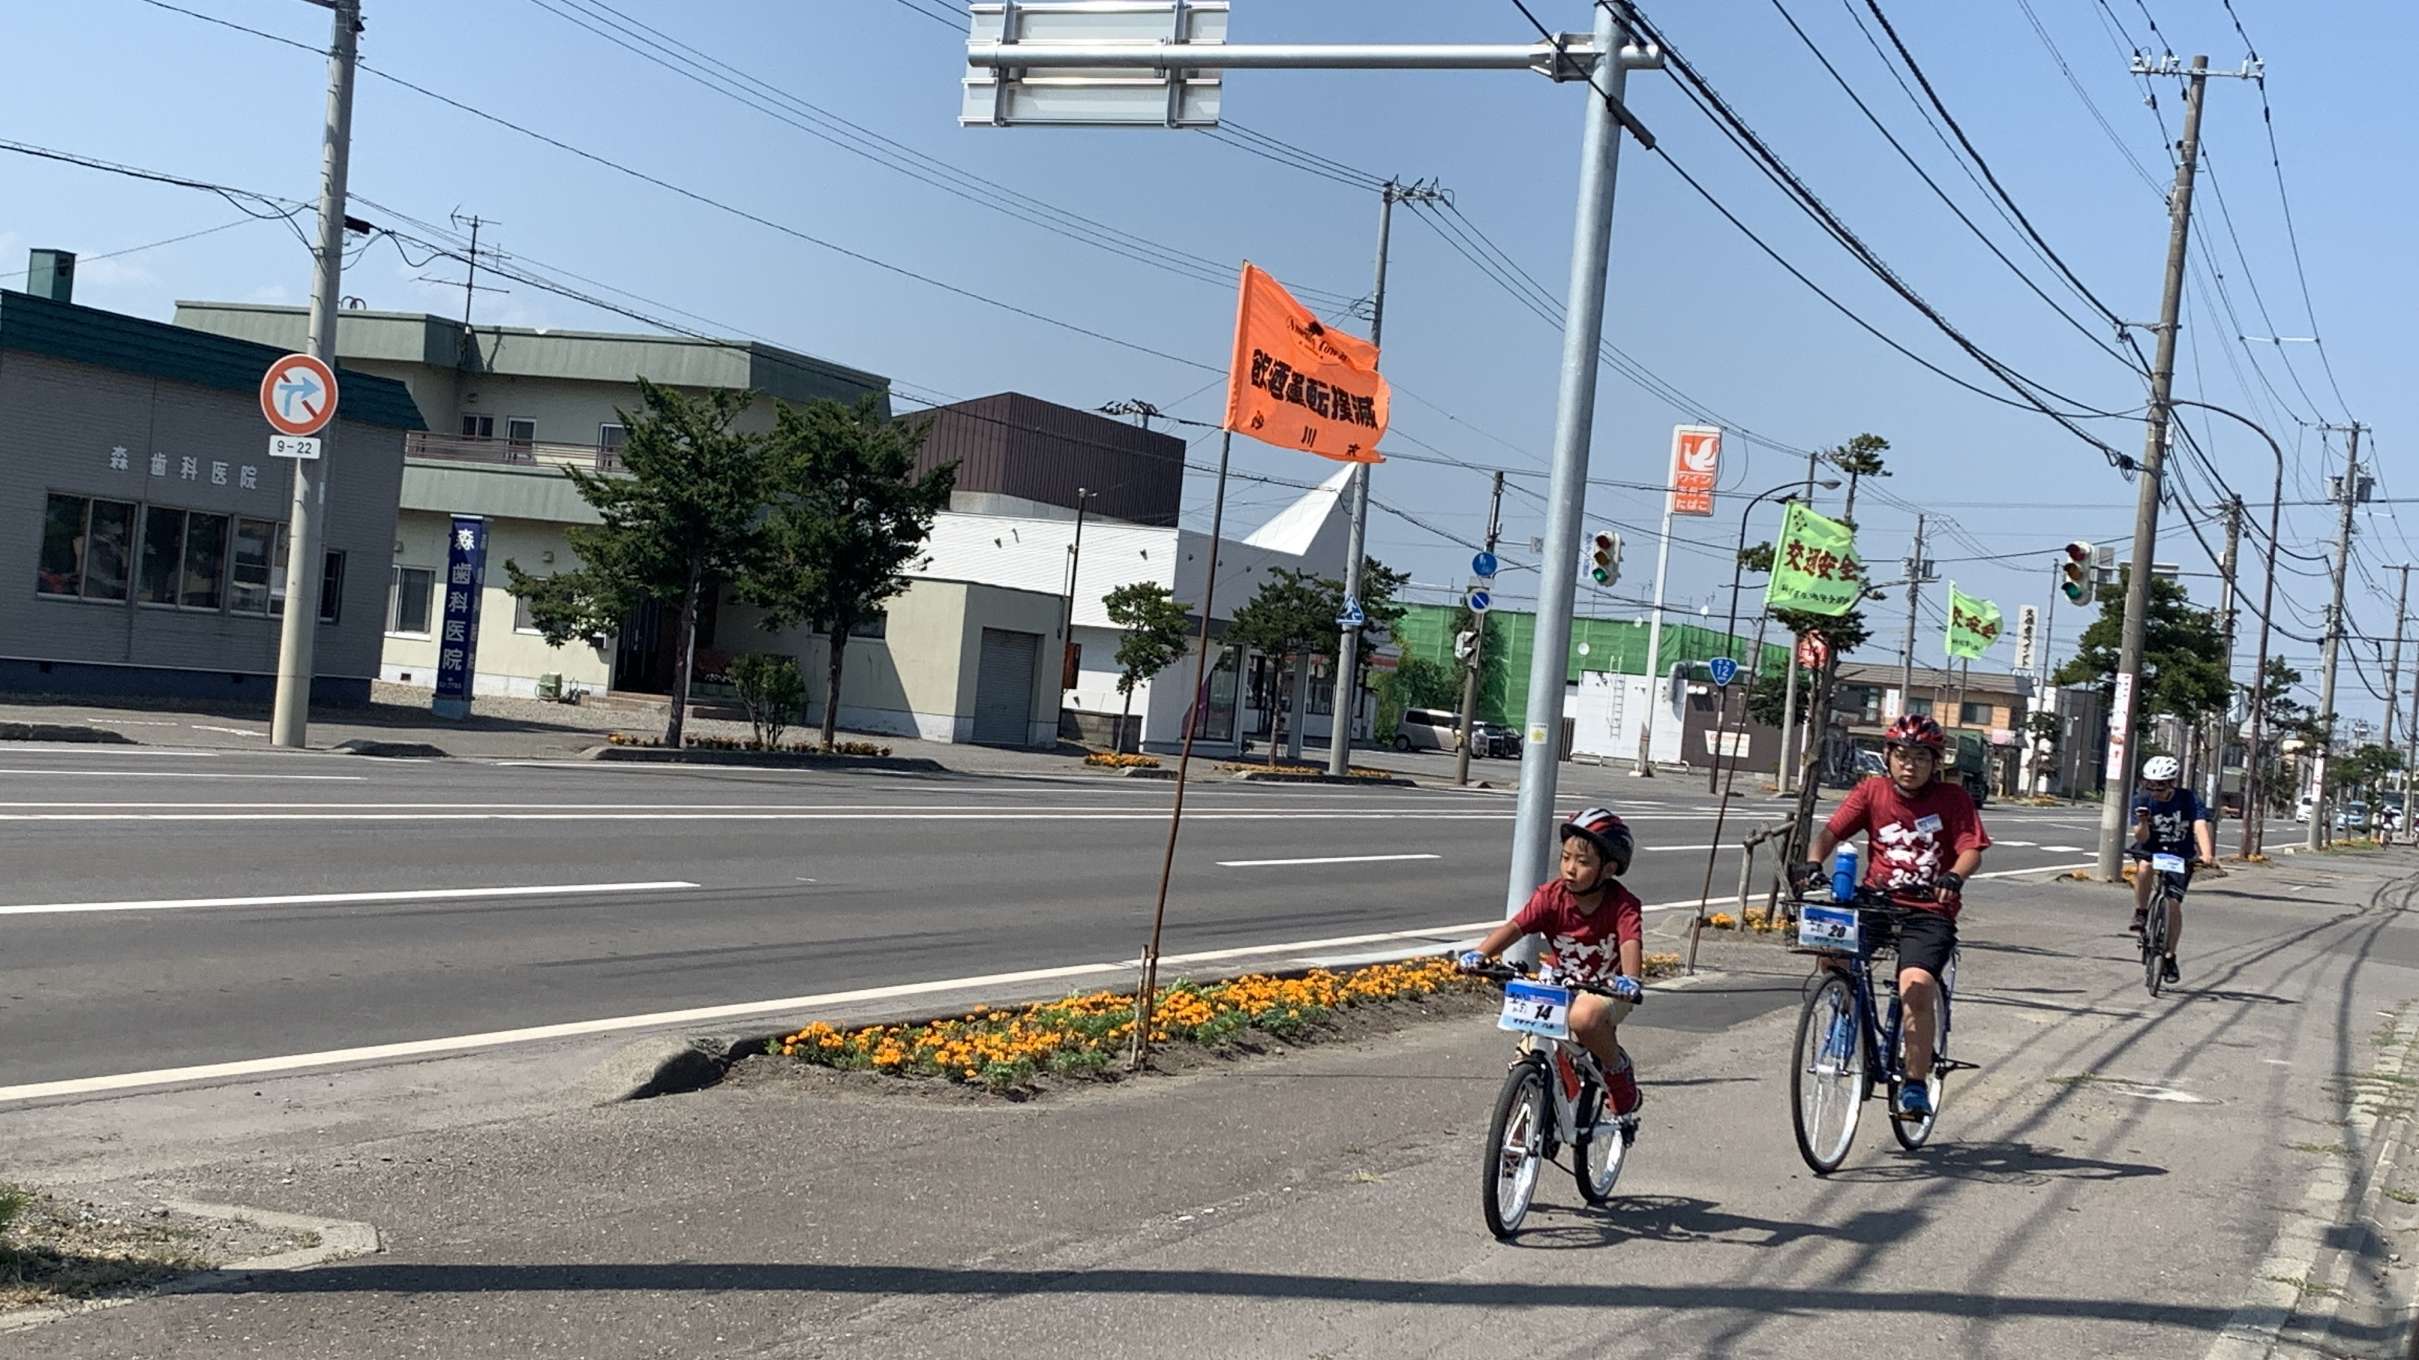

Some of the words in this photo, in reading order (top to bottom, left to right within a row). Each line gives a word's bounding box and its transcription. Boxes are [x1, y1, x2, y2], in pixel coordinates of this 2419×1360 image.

[276, 439, 313, 455] 9-22
[109, 445, 257, 490] 森歯科医院
[1784, 539, 1858, 581] 交通安全
[442, 528, 475, 671] 森歯科医院
[1717, 664, 1729, 677] 12
[1534, 1004, 1554, 1021] 14
